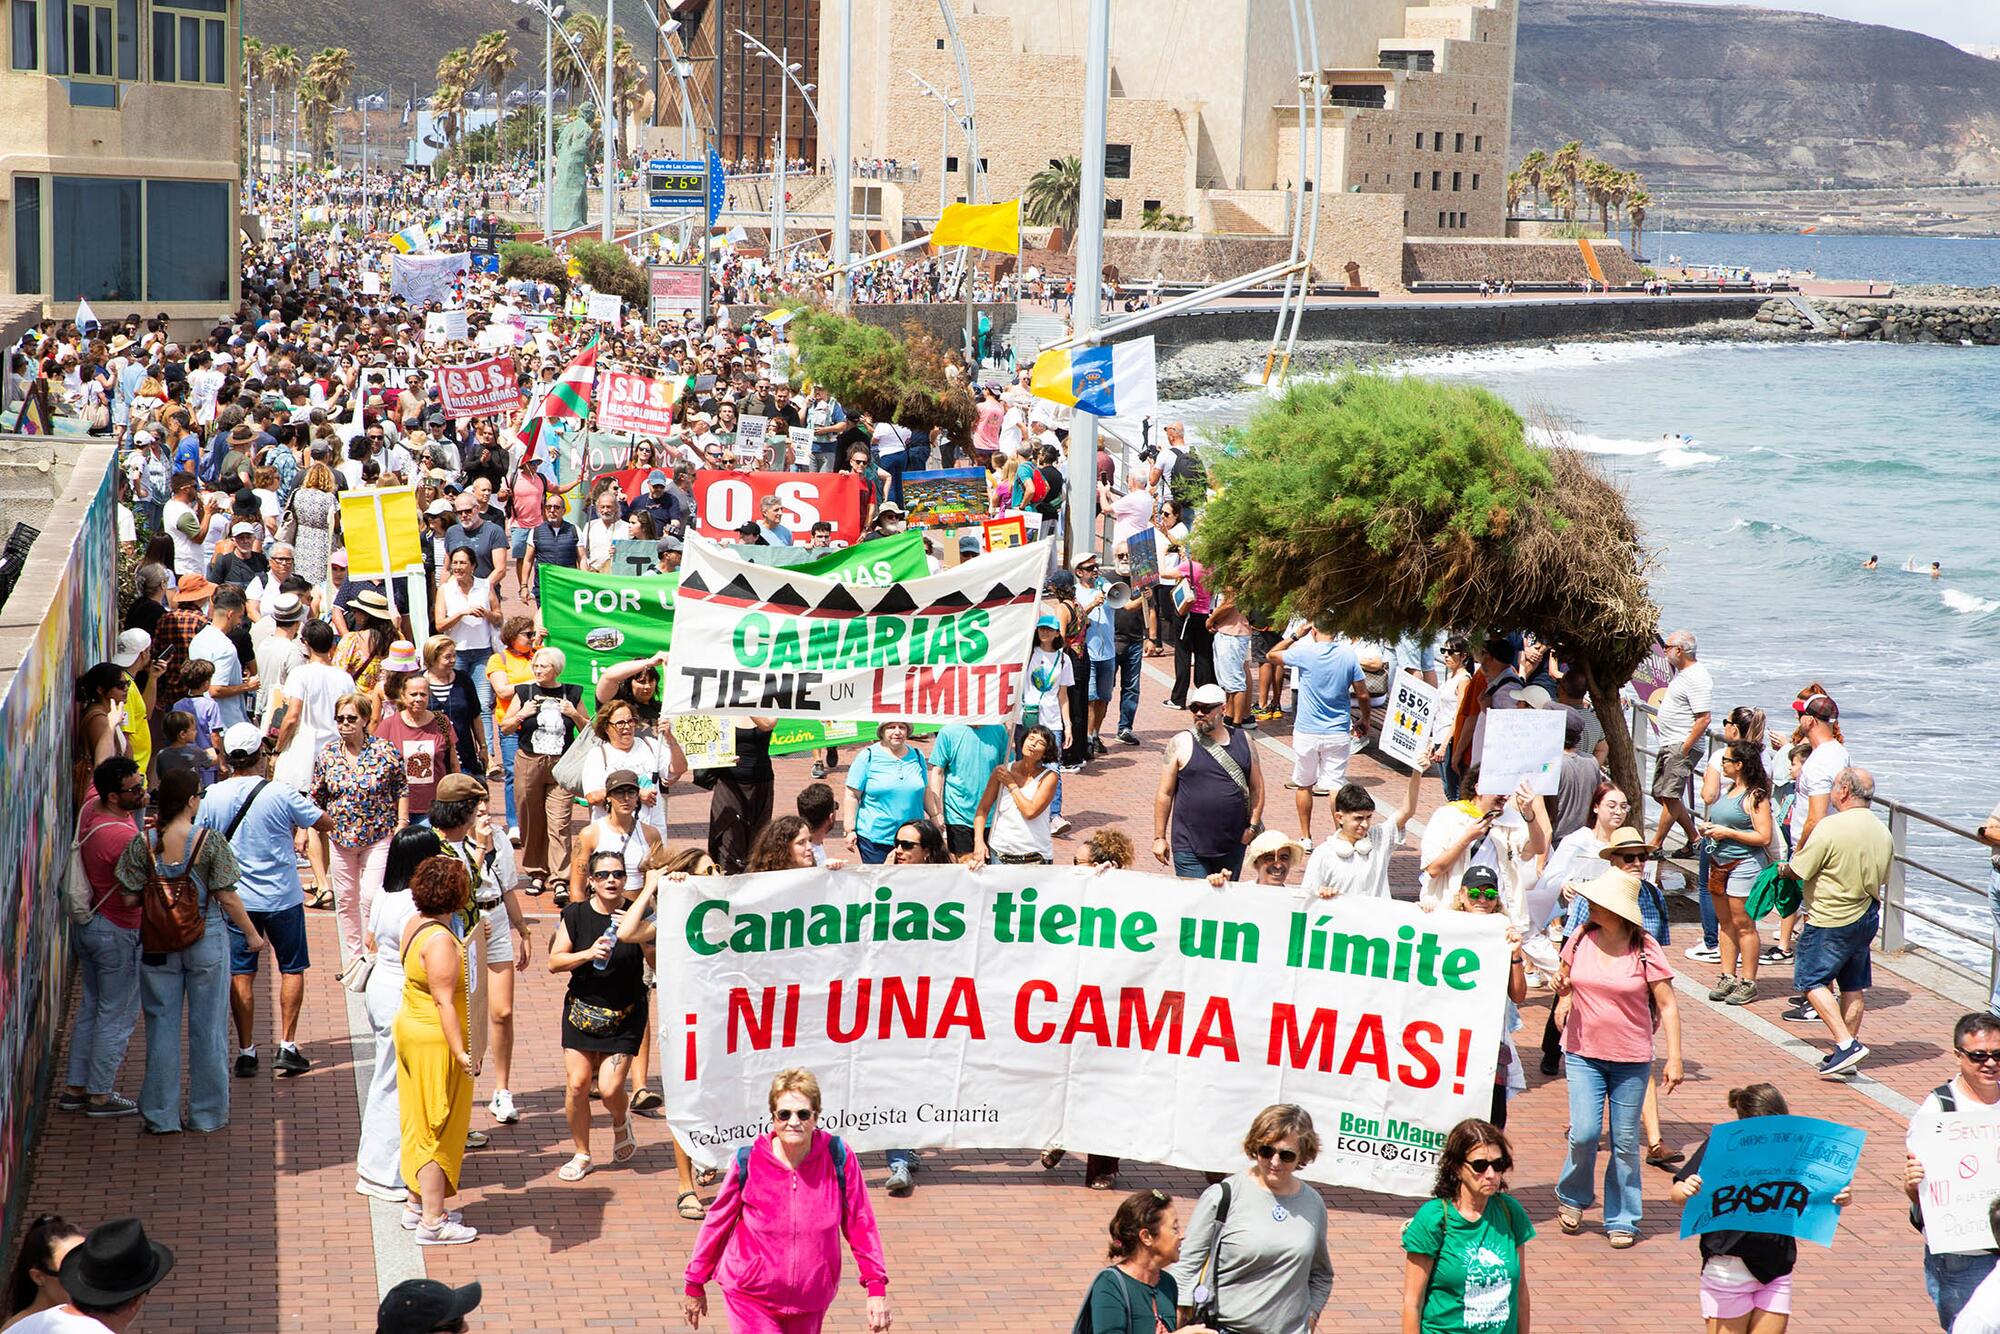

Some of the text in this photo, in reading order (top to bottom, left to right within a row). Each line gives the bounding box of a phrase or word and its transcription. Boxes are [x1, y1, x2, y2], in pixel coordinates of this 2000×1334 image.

[451, 388, 518, 408] MASPALOMAS
[608, 403, 670, 422] MASPALOMAS
[570, 446, 605, 472] NO
[574, 589, 640, 614] POR
[733, 609, 989, 670] CANARIAS
[681, 663, 1023, 717] TIENE UN LÍMITE
[1398, 688, 1429, 716] 85%
[770, 730, 814, 746] Acción
[686, 887, 1480, 991] Canarias tiene un límite
[684, 976, 1472, 1095] ¡ NI UNA CAMA MAS!
[816, 1106, 907, 1130] cologista
[916, 1103, 999, 1123] Canaria
[1339, 1112, 1447, 1149] Ben Mage
[1338, 1137, 1439, 1164] ECOLOGIST
[1712, 1181, 1810, 1217] BASTA
